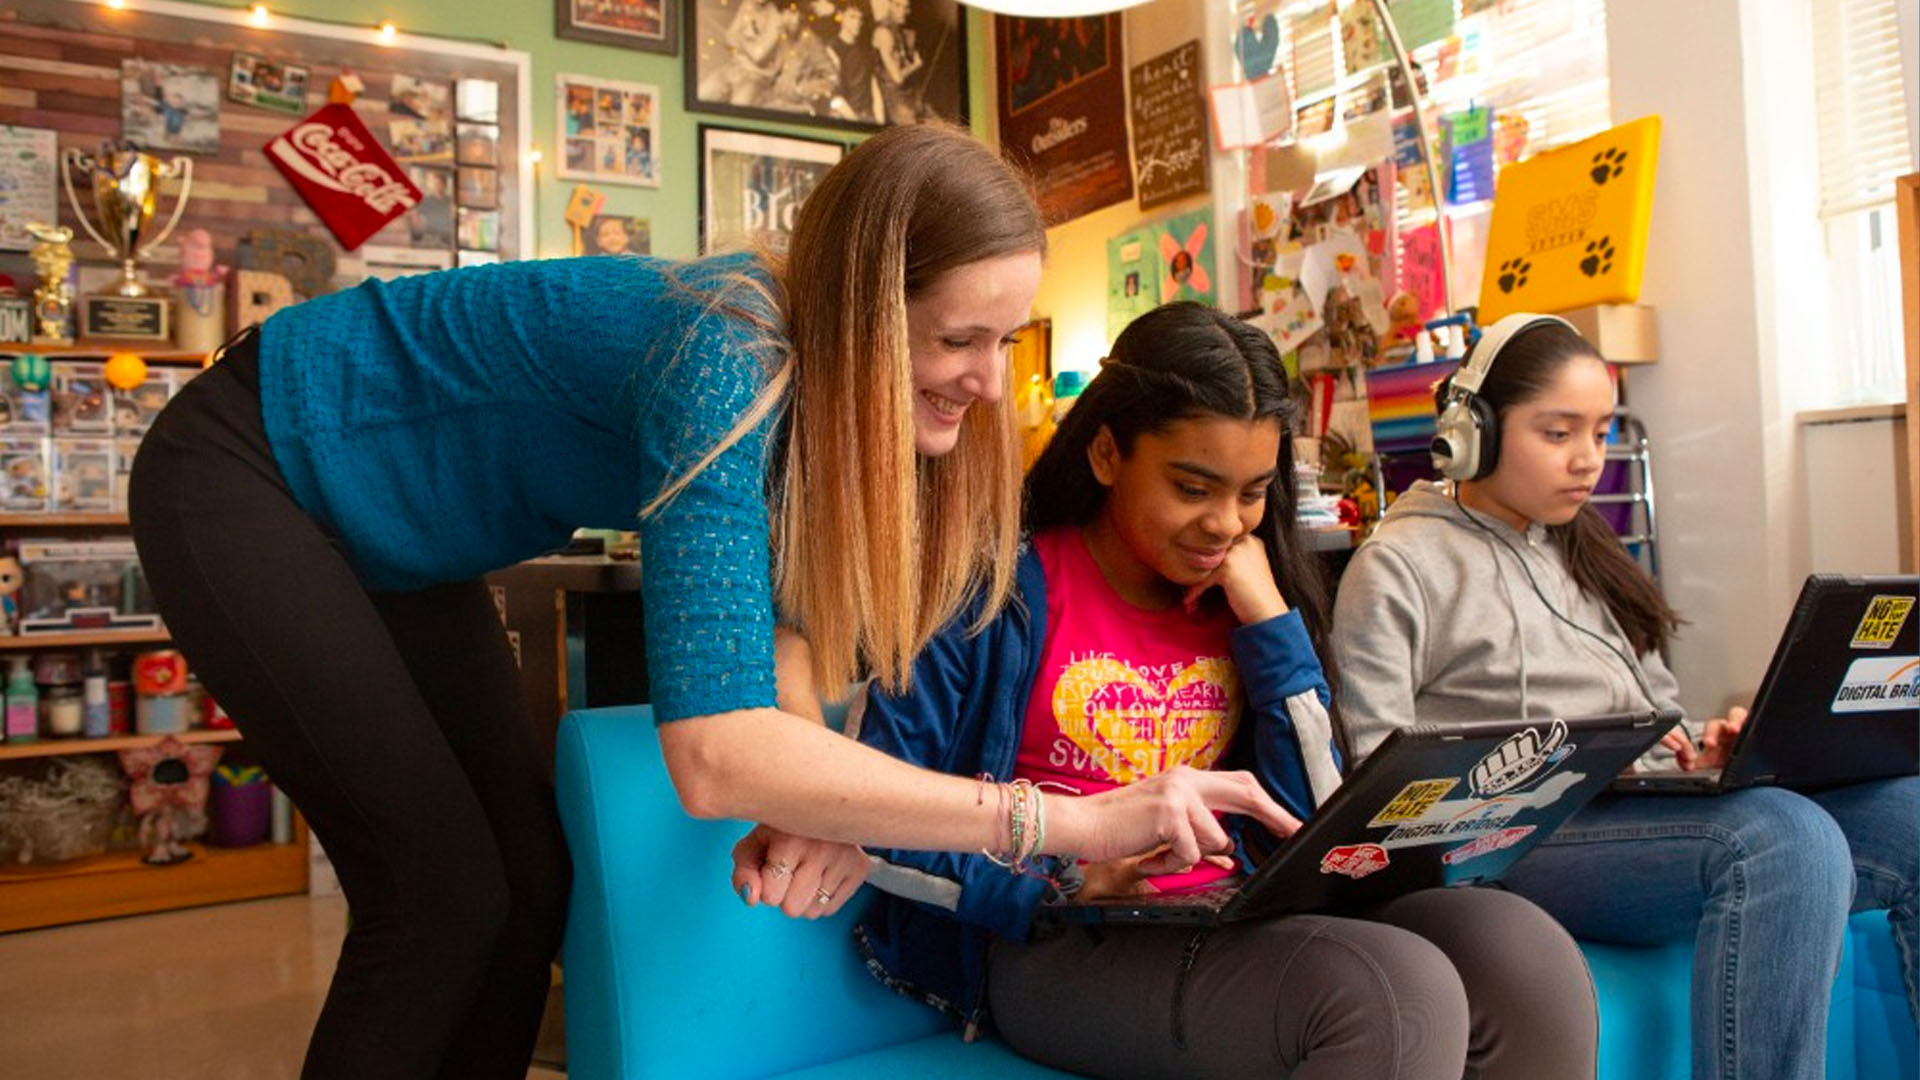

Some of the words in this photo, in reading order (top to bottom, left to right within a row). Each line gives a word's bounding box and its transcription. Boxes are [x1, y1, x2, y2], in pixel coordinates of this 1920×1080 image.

[1866, 600, 1893, 620] NO
[1857, 621, 1901, 639] HATE
[1837, 684, 1888, 701] DIGITAL
[1387, 822, 1451, 841] DIGITAL
